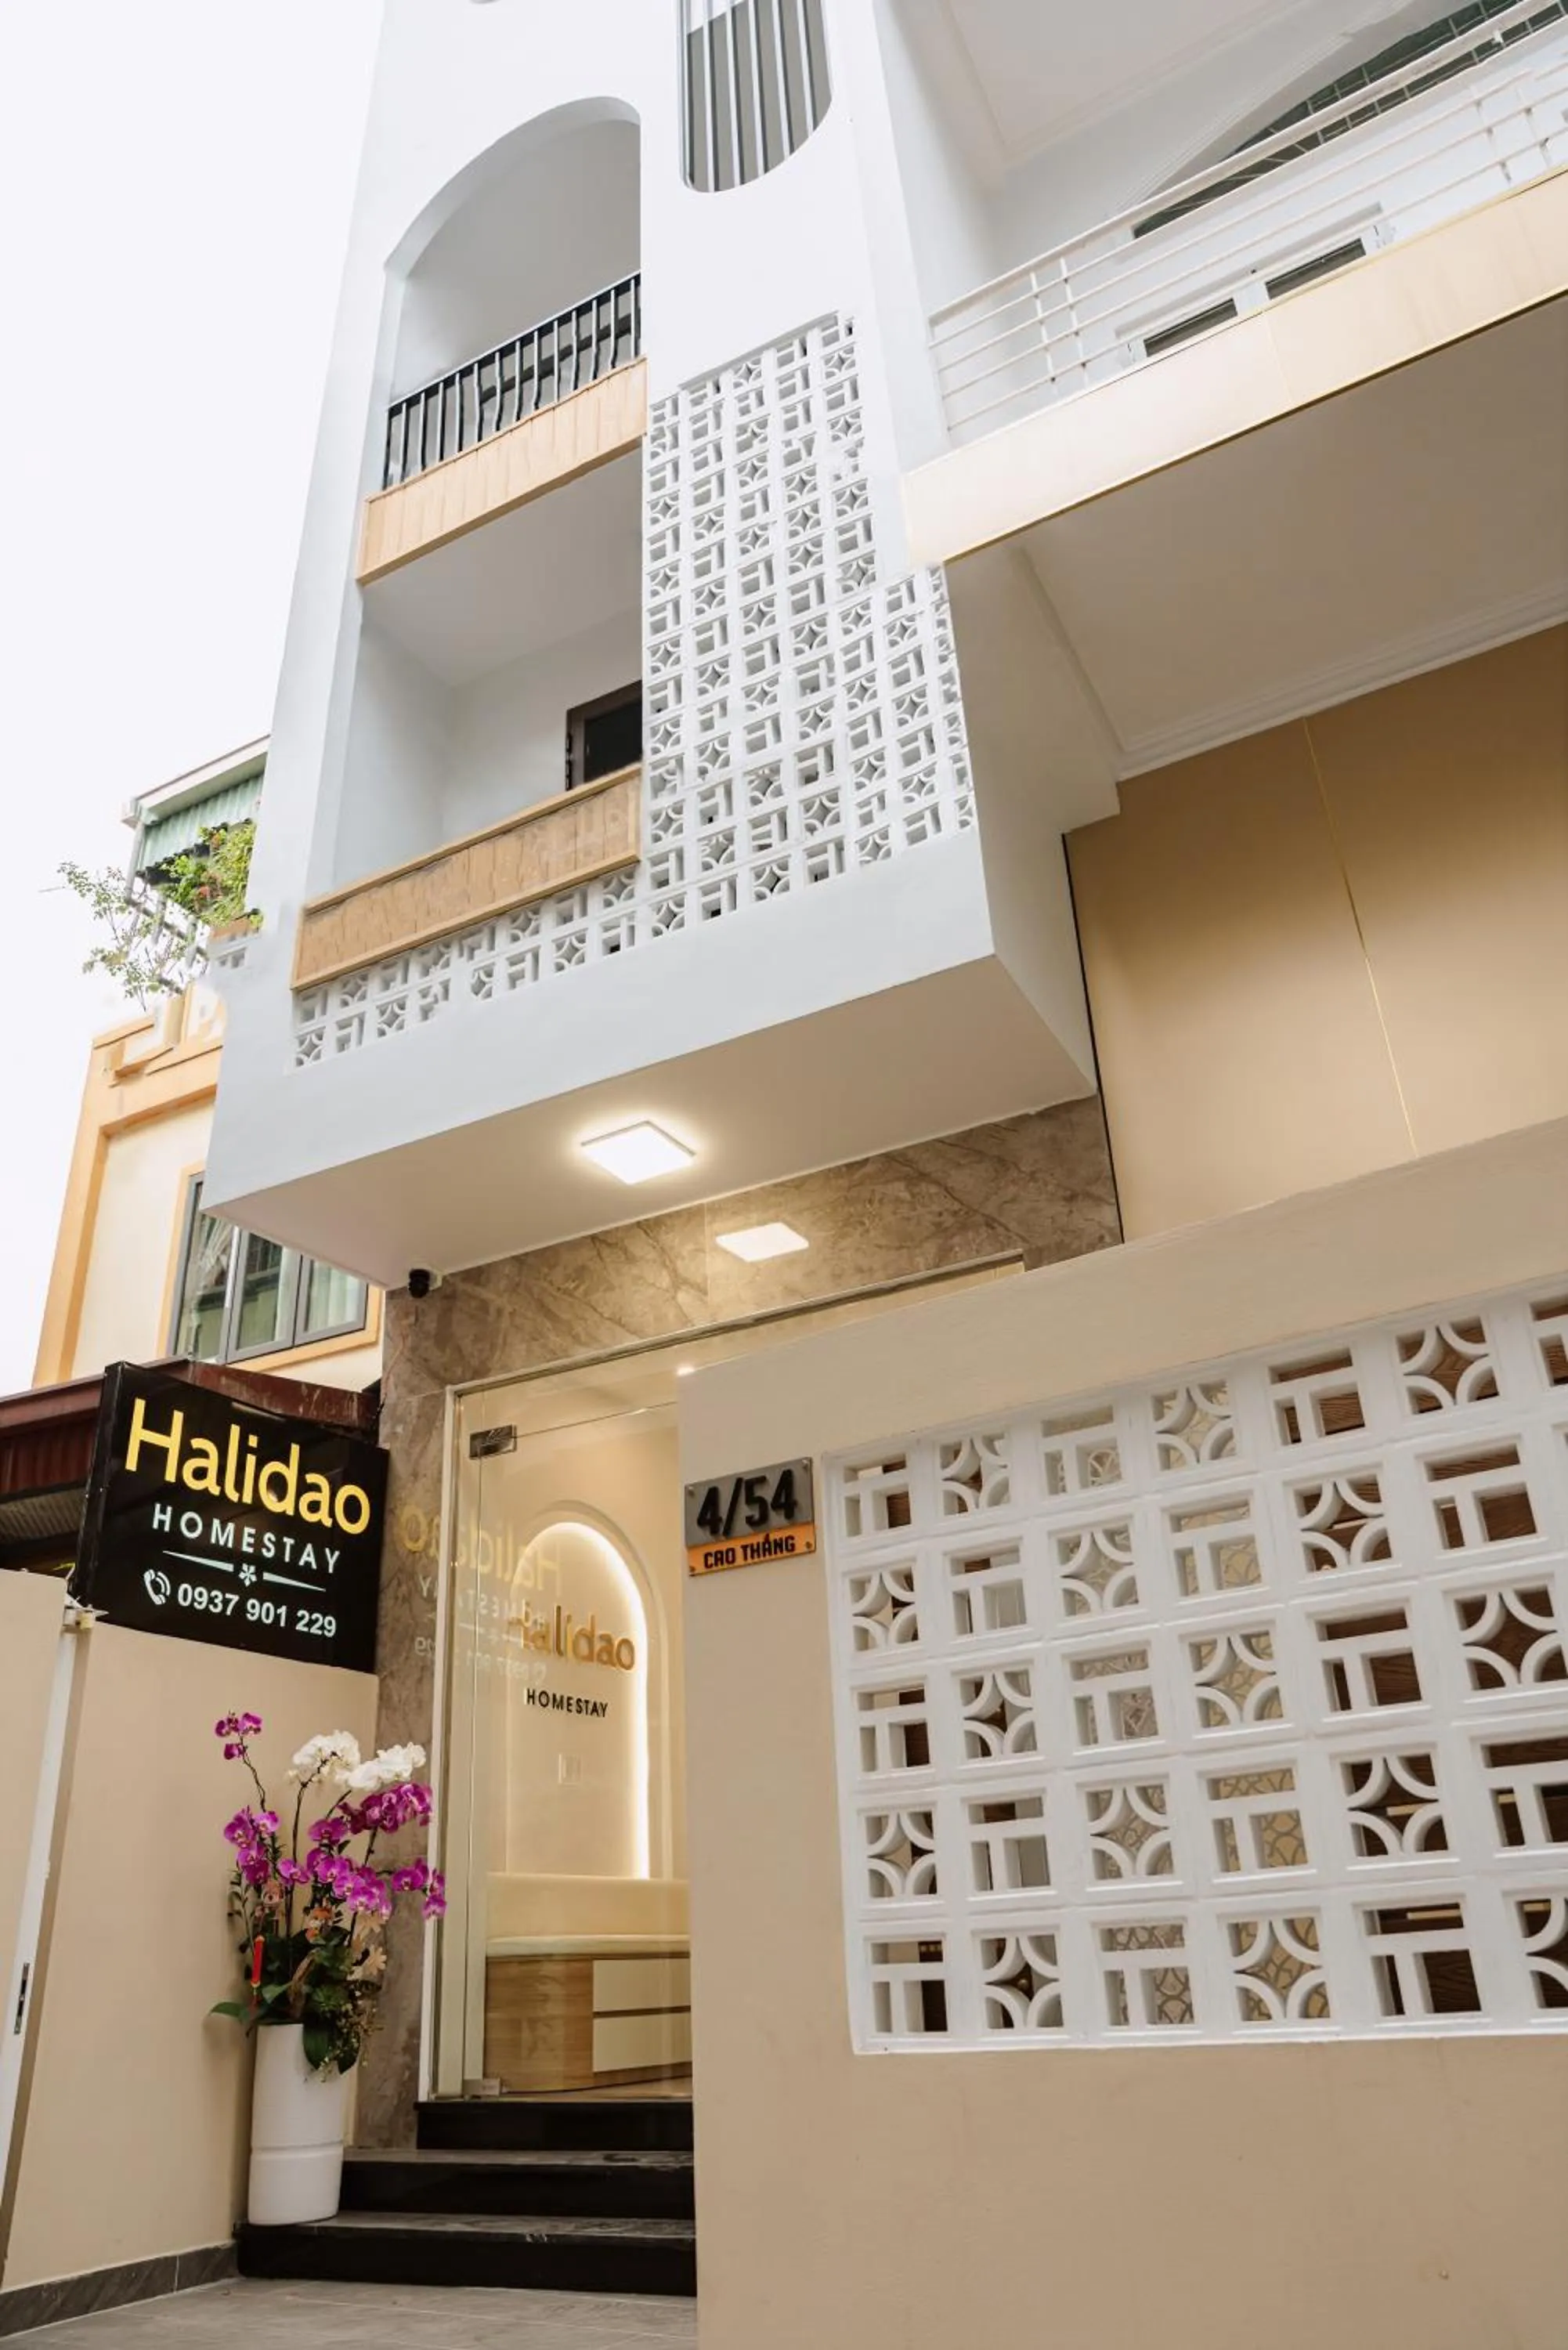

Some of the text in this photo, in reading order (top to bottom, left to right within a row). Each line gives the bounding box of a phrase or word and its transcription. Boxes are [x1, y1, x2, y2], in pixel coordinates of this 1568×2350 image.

[124, 1397, 370, 1535] Halidao
[697, 1469, 798, 1537] 4/54
[152, 1502, 341, 1574] HOMESTAY
[703, 1546, 737, 1569] CAO
[178, 1582, 337, 1638] 0937 901 229
[526, 1687, 609, 1718] HOMESTAY
